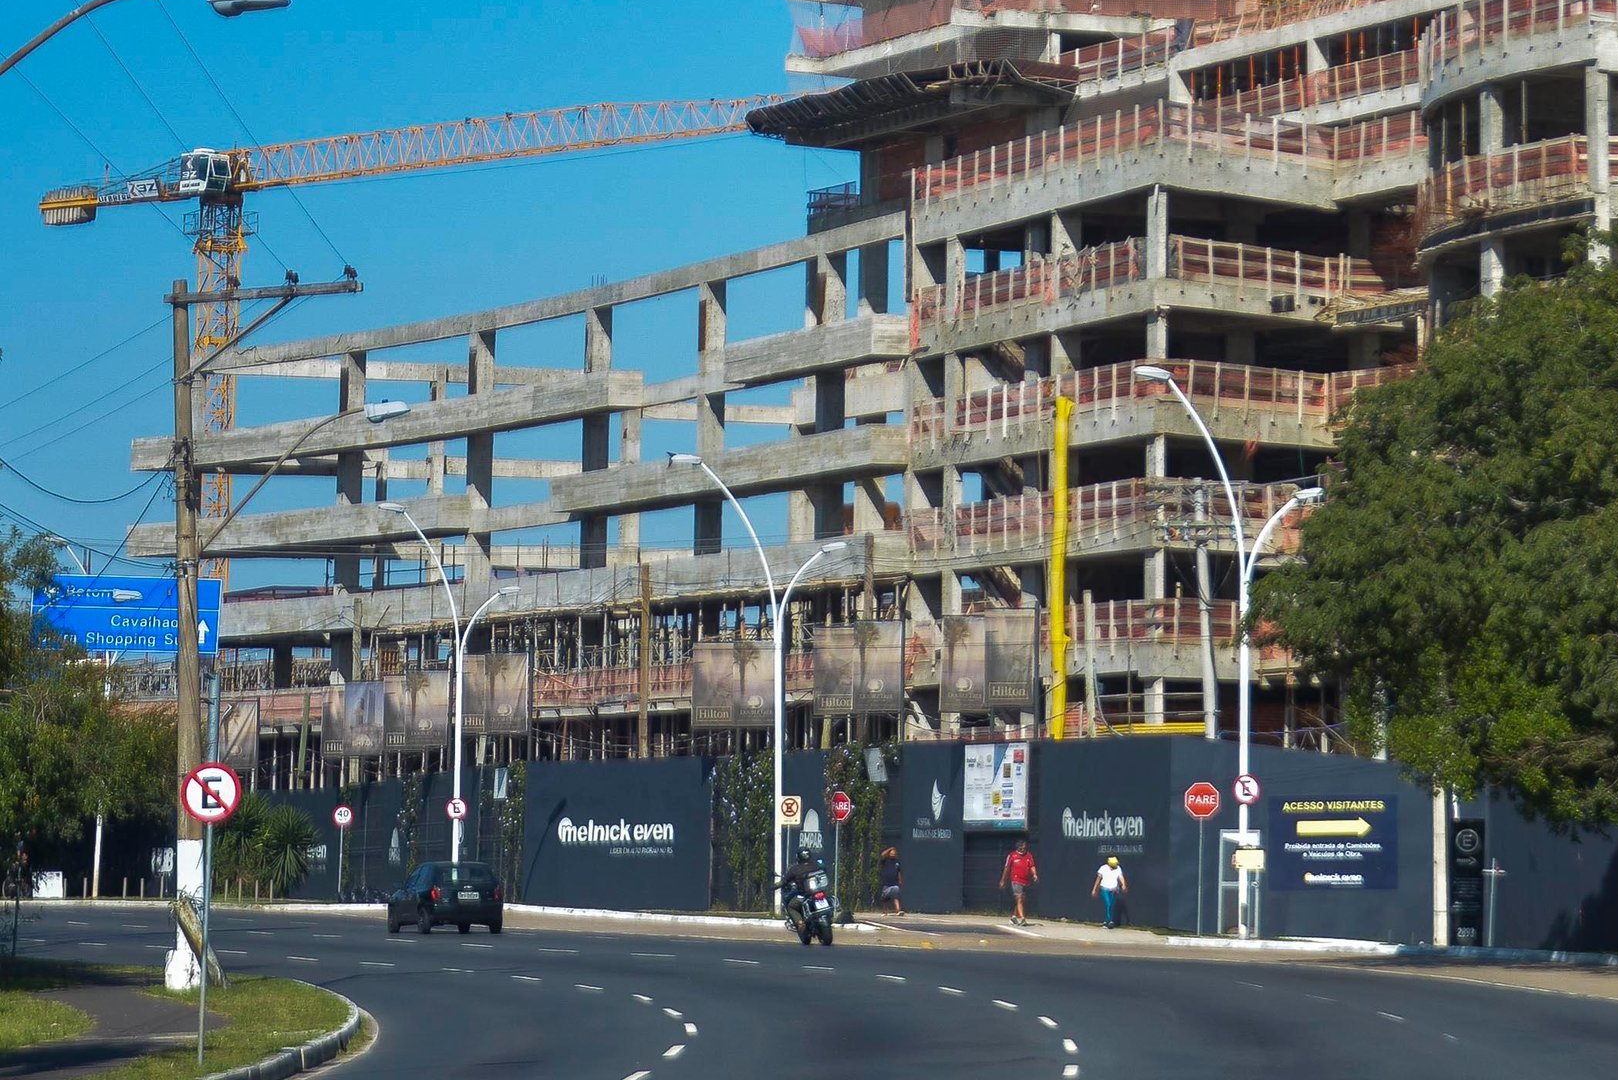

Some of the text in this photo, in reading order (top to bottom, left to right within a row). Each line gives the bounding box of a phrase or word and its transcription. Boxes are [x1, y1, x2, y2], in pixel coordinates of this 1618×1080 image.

[86, 632, 156, 646] Shopping
[164, 634, 178, 646] Su
[992, 686, 1026, 697] Hilton
[699, 709, 730, 719] Hilton
[1187, 794, 1217, 805] PARE
[1283, 800, 1385, 811] ACESSO VISITANTES
[337, 809, 349, 818] 40
[1062, 807, 1143, 837] melnick even
[558, 817, 674, 842] melnick even
